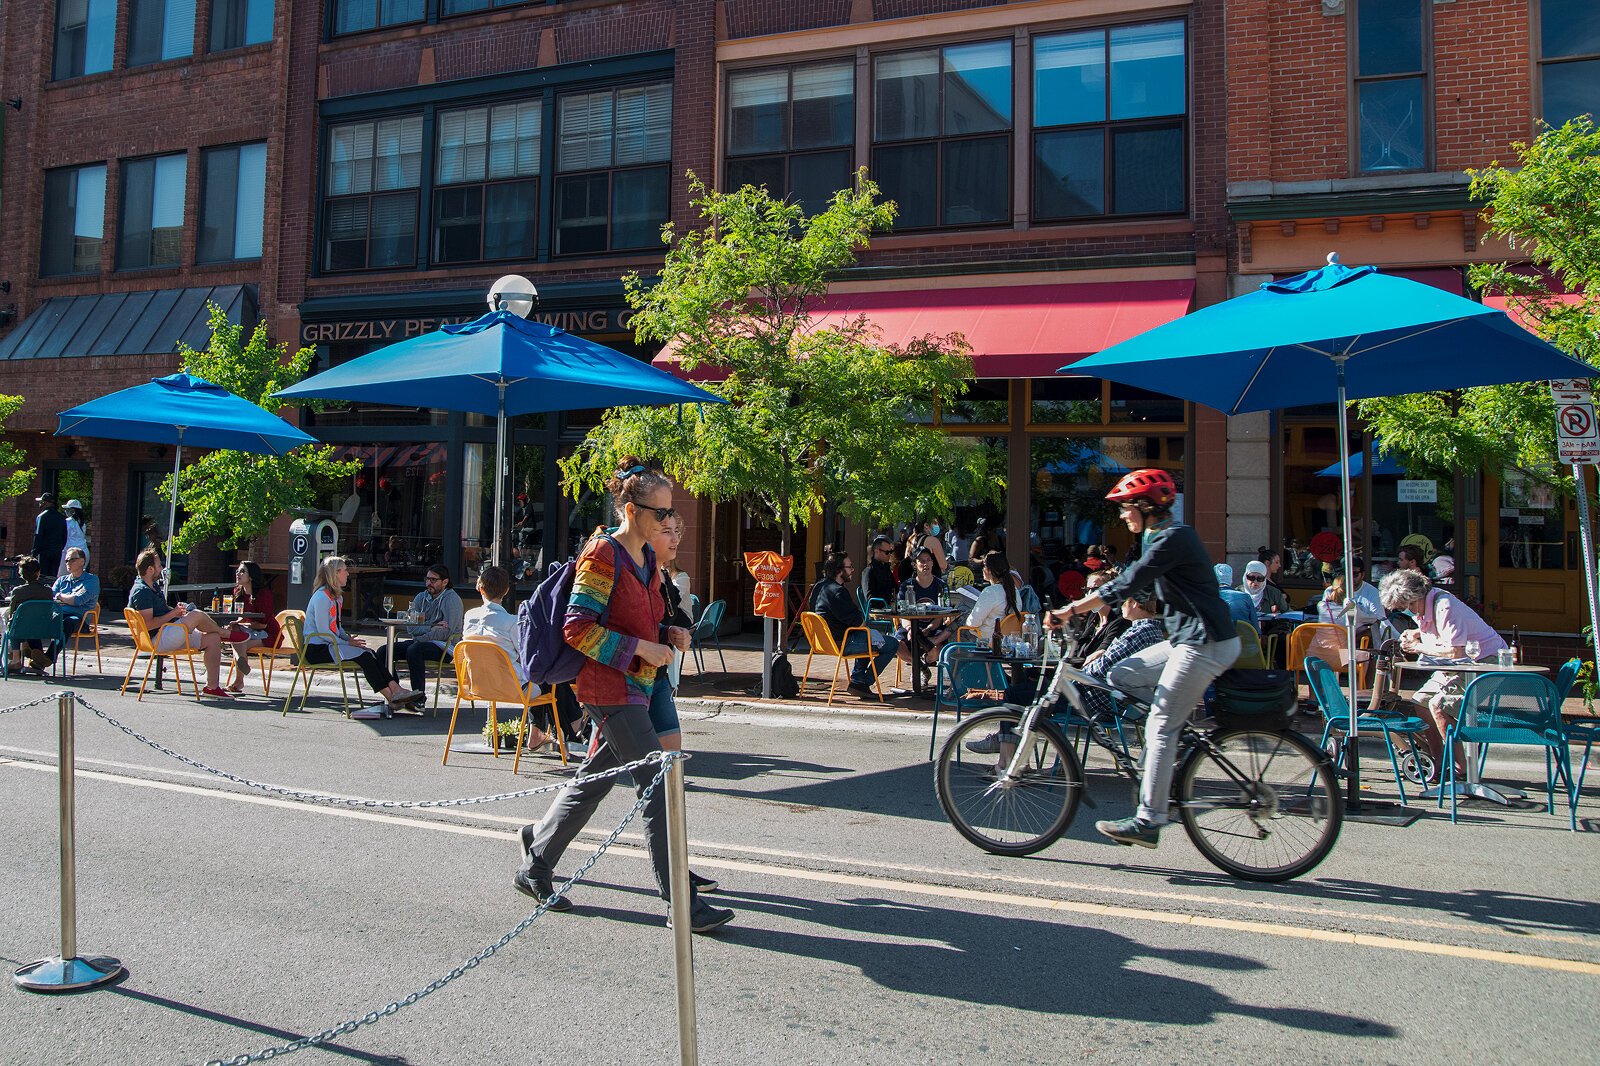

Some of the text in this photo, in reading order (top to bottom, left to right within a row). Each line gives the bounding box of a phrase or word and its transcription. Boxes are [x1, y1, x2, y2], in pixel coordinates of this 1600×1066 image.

[303, 321, 397, 341] GRIZZLY
[533, 310, 609, 331] WING
[297, 538, 305, 552] P
